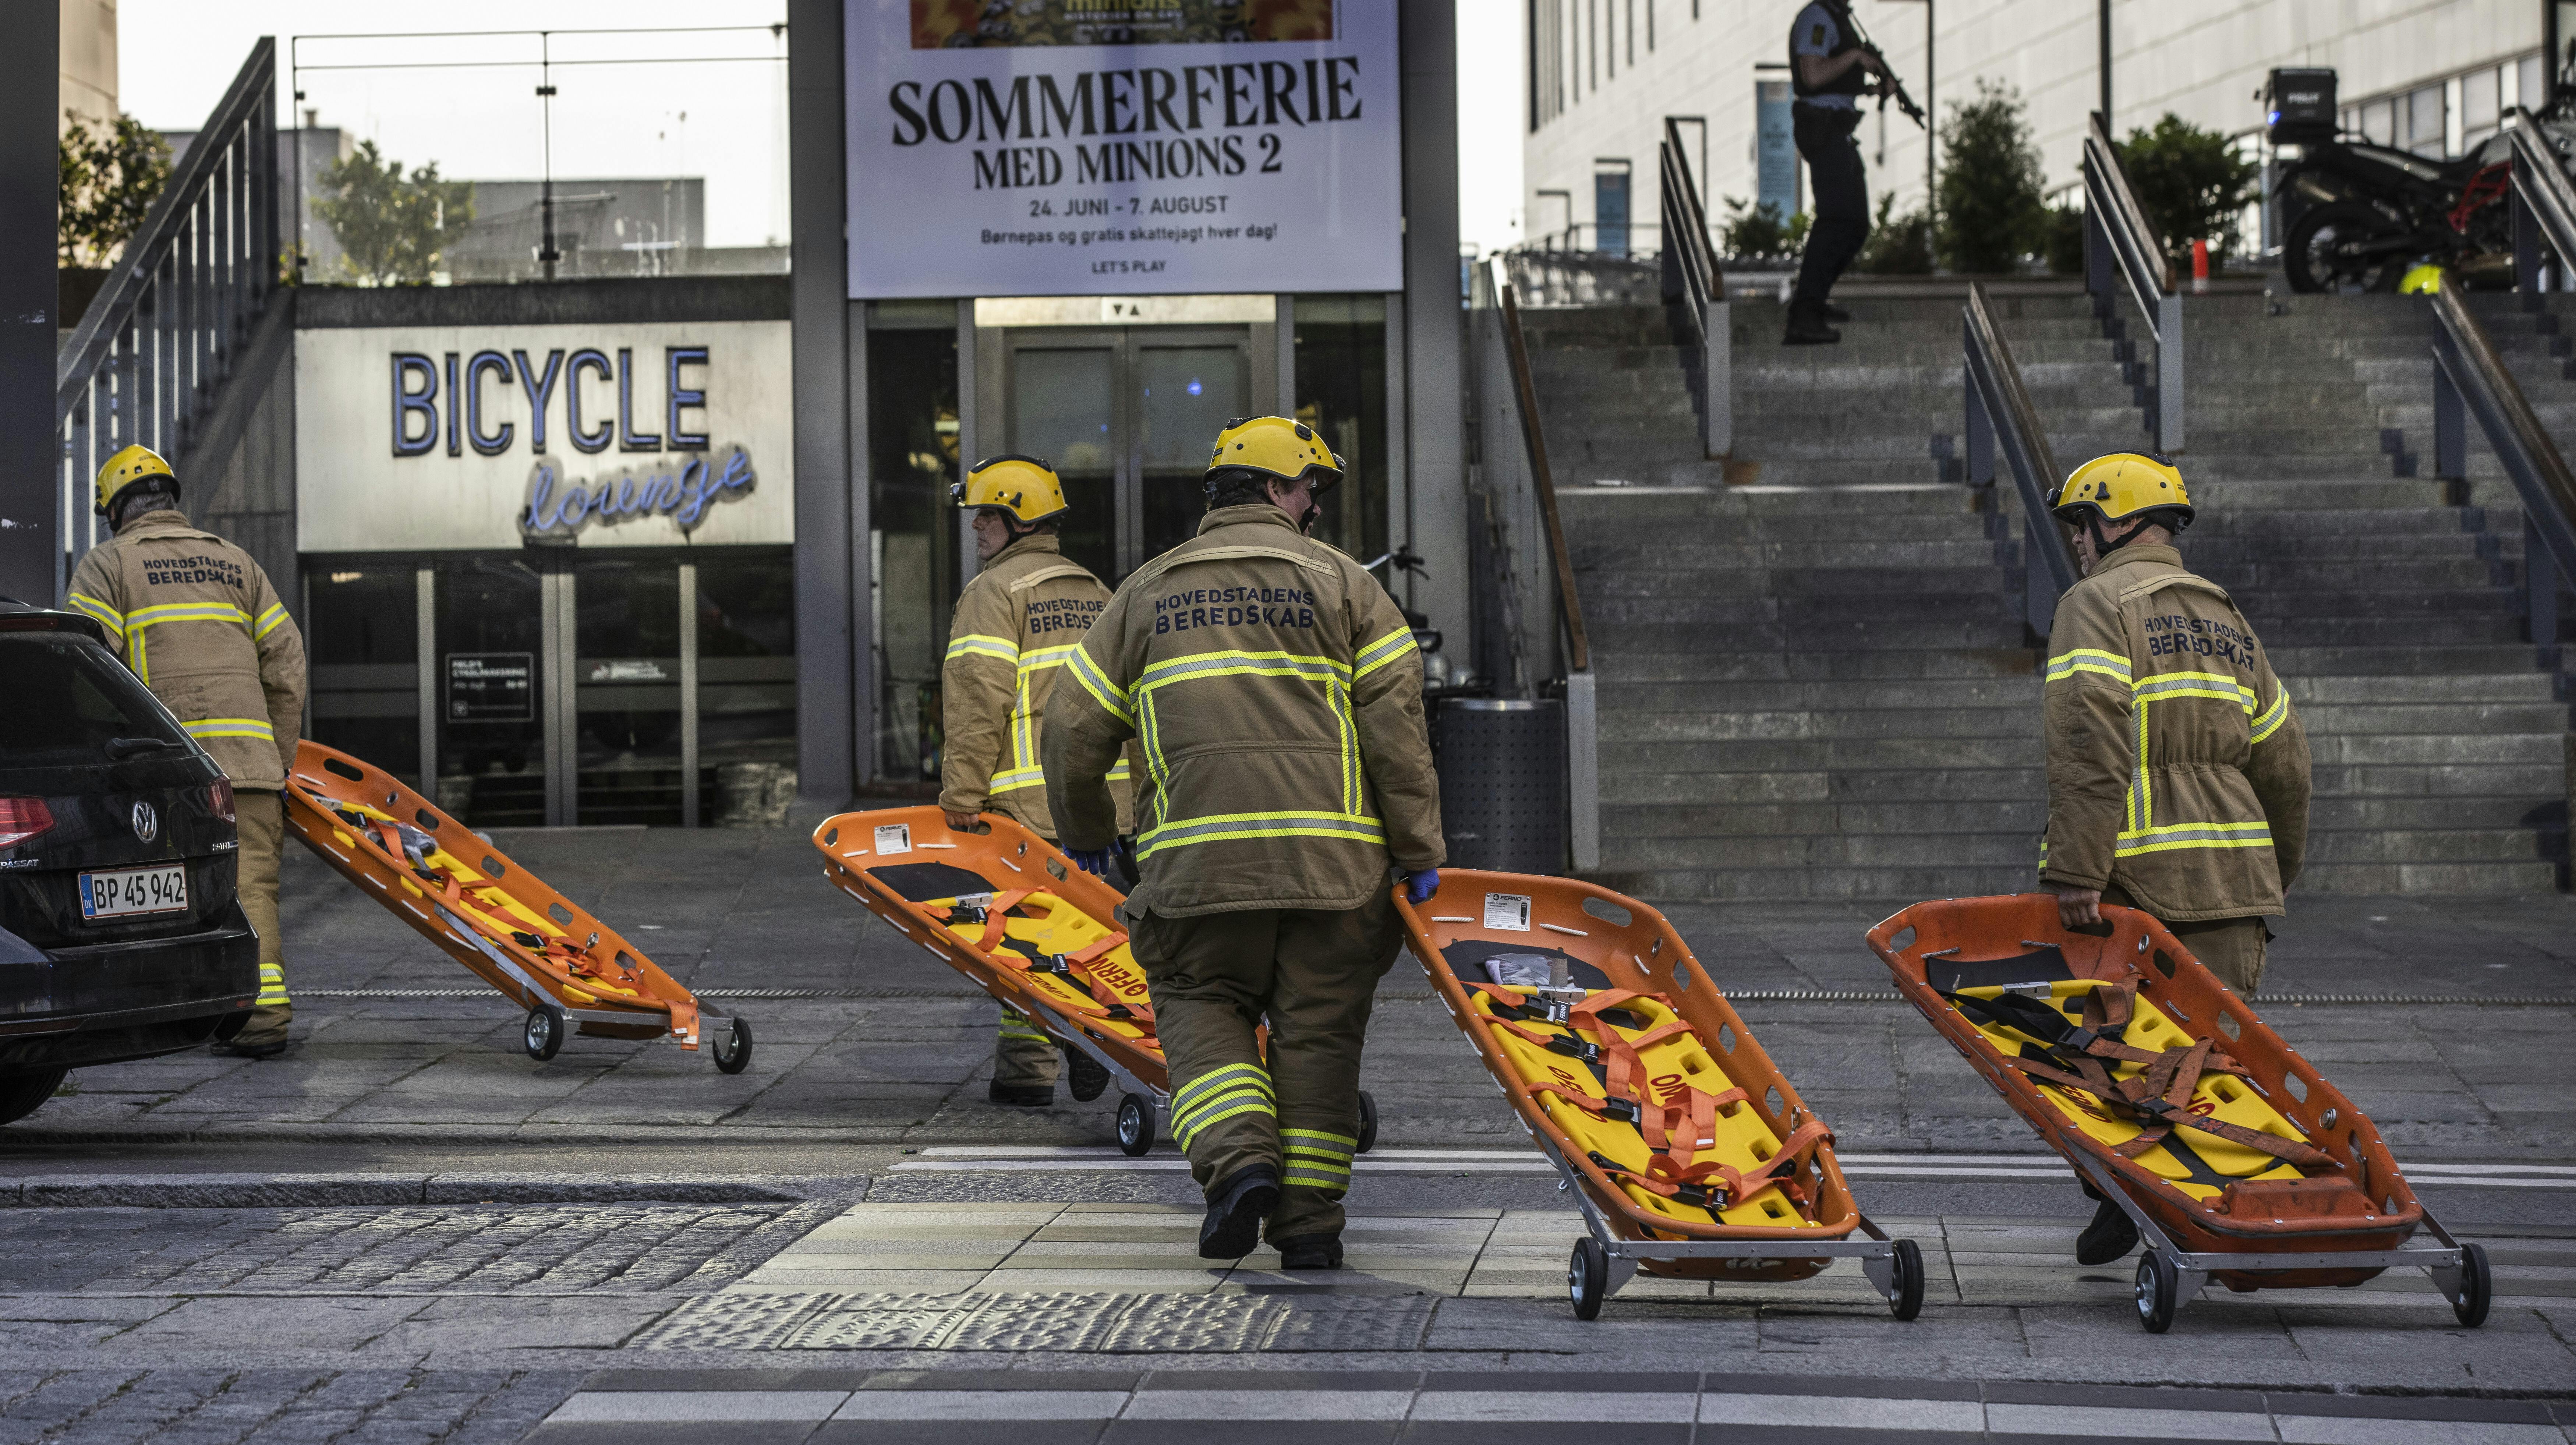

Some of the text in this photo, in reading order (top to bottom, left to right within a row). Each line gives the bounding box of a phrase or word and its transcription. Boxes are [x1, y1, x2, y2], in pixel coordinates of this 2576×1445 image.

[889, 56, 1361, 145] SOMMERFERIE
[973, 133, 1283, 189] MED MINIONS 2
[1030, 199, 1056, 217] 24.
[1064, 198, 1108, 216] JUNI
[1150, 195, 1229, 215] AUGUST
[981, 222, 1278, 246] Børnepas og gratis skattejagt hver dag!
[1091, 259, 1166, 274] LET'S PLAY
[391, 346, 710, 457] BICYCLE
[525, 452, 753, 531] lounge
[143, 555, 242, 575] HOVEDSTADENS
[1027, 598, 1106, 615] HOVEDSTADE
[1156, 587, 1314, 614] HOVEDSTADENS
[1156, 605, 1314, 635] BEREDSKAB
[2144, 615, 2254, 651] HOVEDSTADENS
[2148, 632, 2254, 672] BEREDSKAB
[0, 859, 39, 869] PASSAT
[84, 899, 92, 909] DK
[94, 872, 184, 909] BP 45 942
[1057, 955, 1066, 968] FERNO
